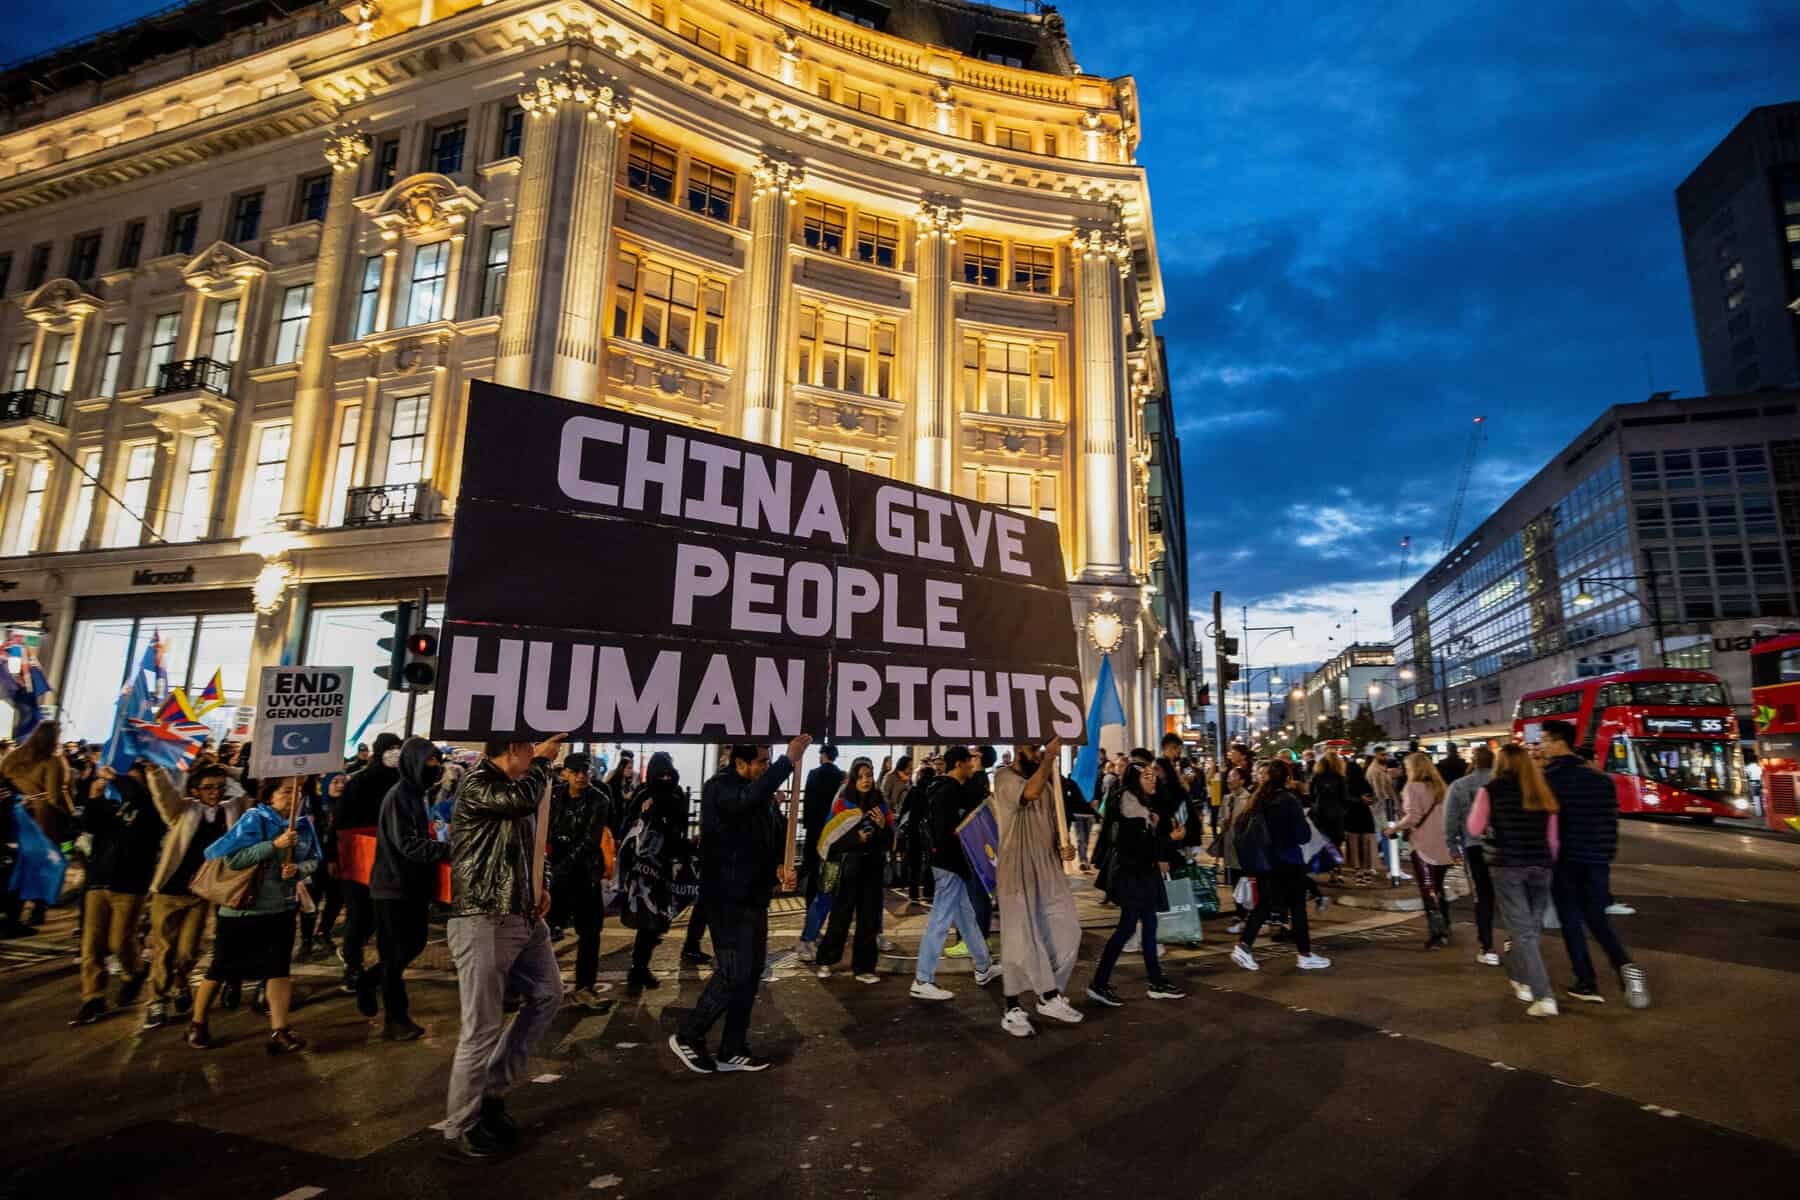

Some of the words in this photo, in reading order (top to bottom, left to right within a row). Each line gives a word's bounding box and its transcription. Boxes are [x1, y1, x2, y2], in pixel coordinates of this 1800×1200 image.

[558, 416, 848, 544] CHINA
[875, 486, 1032, 577] GIVE
[672, 543, 965, 649] PEOPLE
[275, 673, 341, 693] END
[443, 636, 805, 736] HUMAN
[835, 662, 1083, 739] RIGHTS
[268, 693, 344, 707] UYGHUR
[265, 706, 344, 719] GENOCIDE
[1701, 719, 1722, 732] 55
